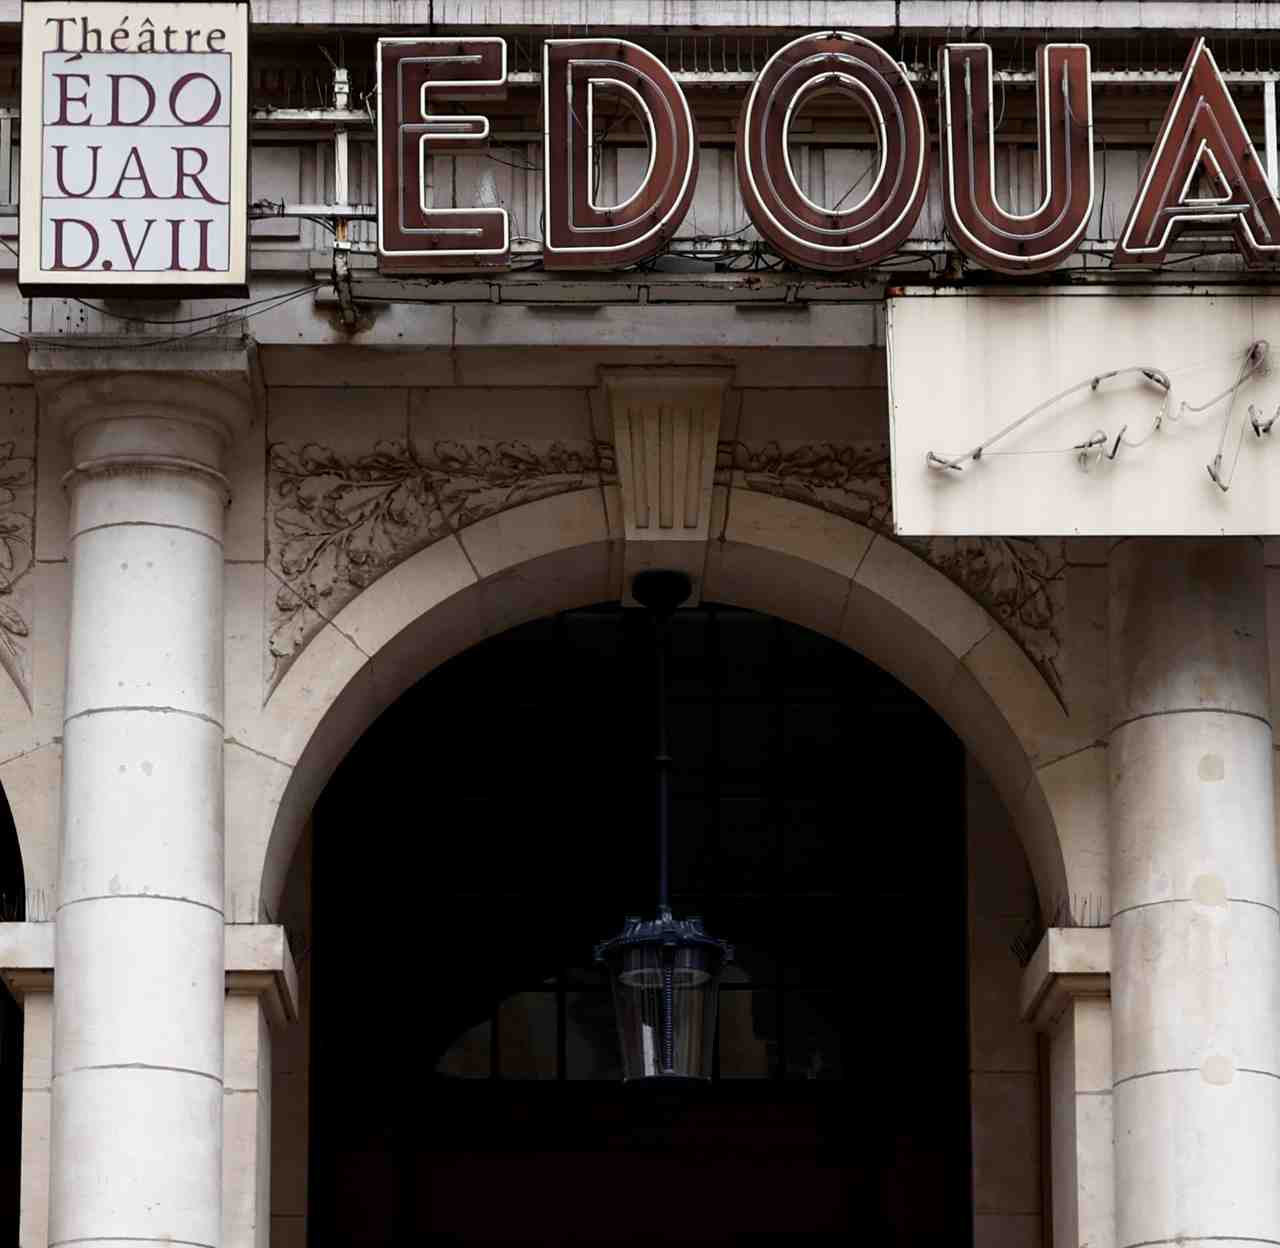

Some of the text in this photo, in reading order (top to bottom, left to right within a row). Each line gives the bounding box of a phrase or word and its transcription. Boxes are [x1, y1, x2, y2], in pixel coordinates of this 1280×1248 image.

[45, 16, 227, 53] Théâtre
[50, 53, 222, 127] ÉDO
[50, 145, 231, 205] UAR
[49, 218, 217, 272] D.VII
